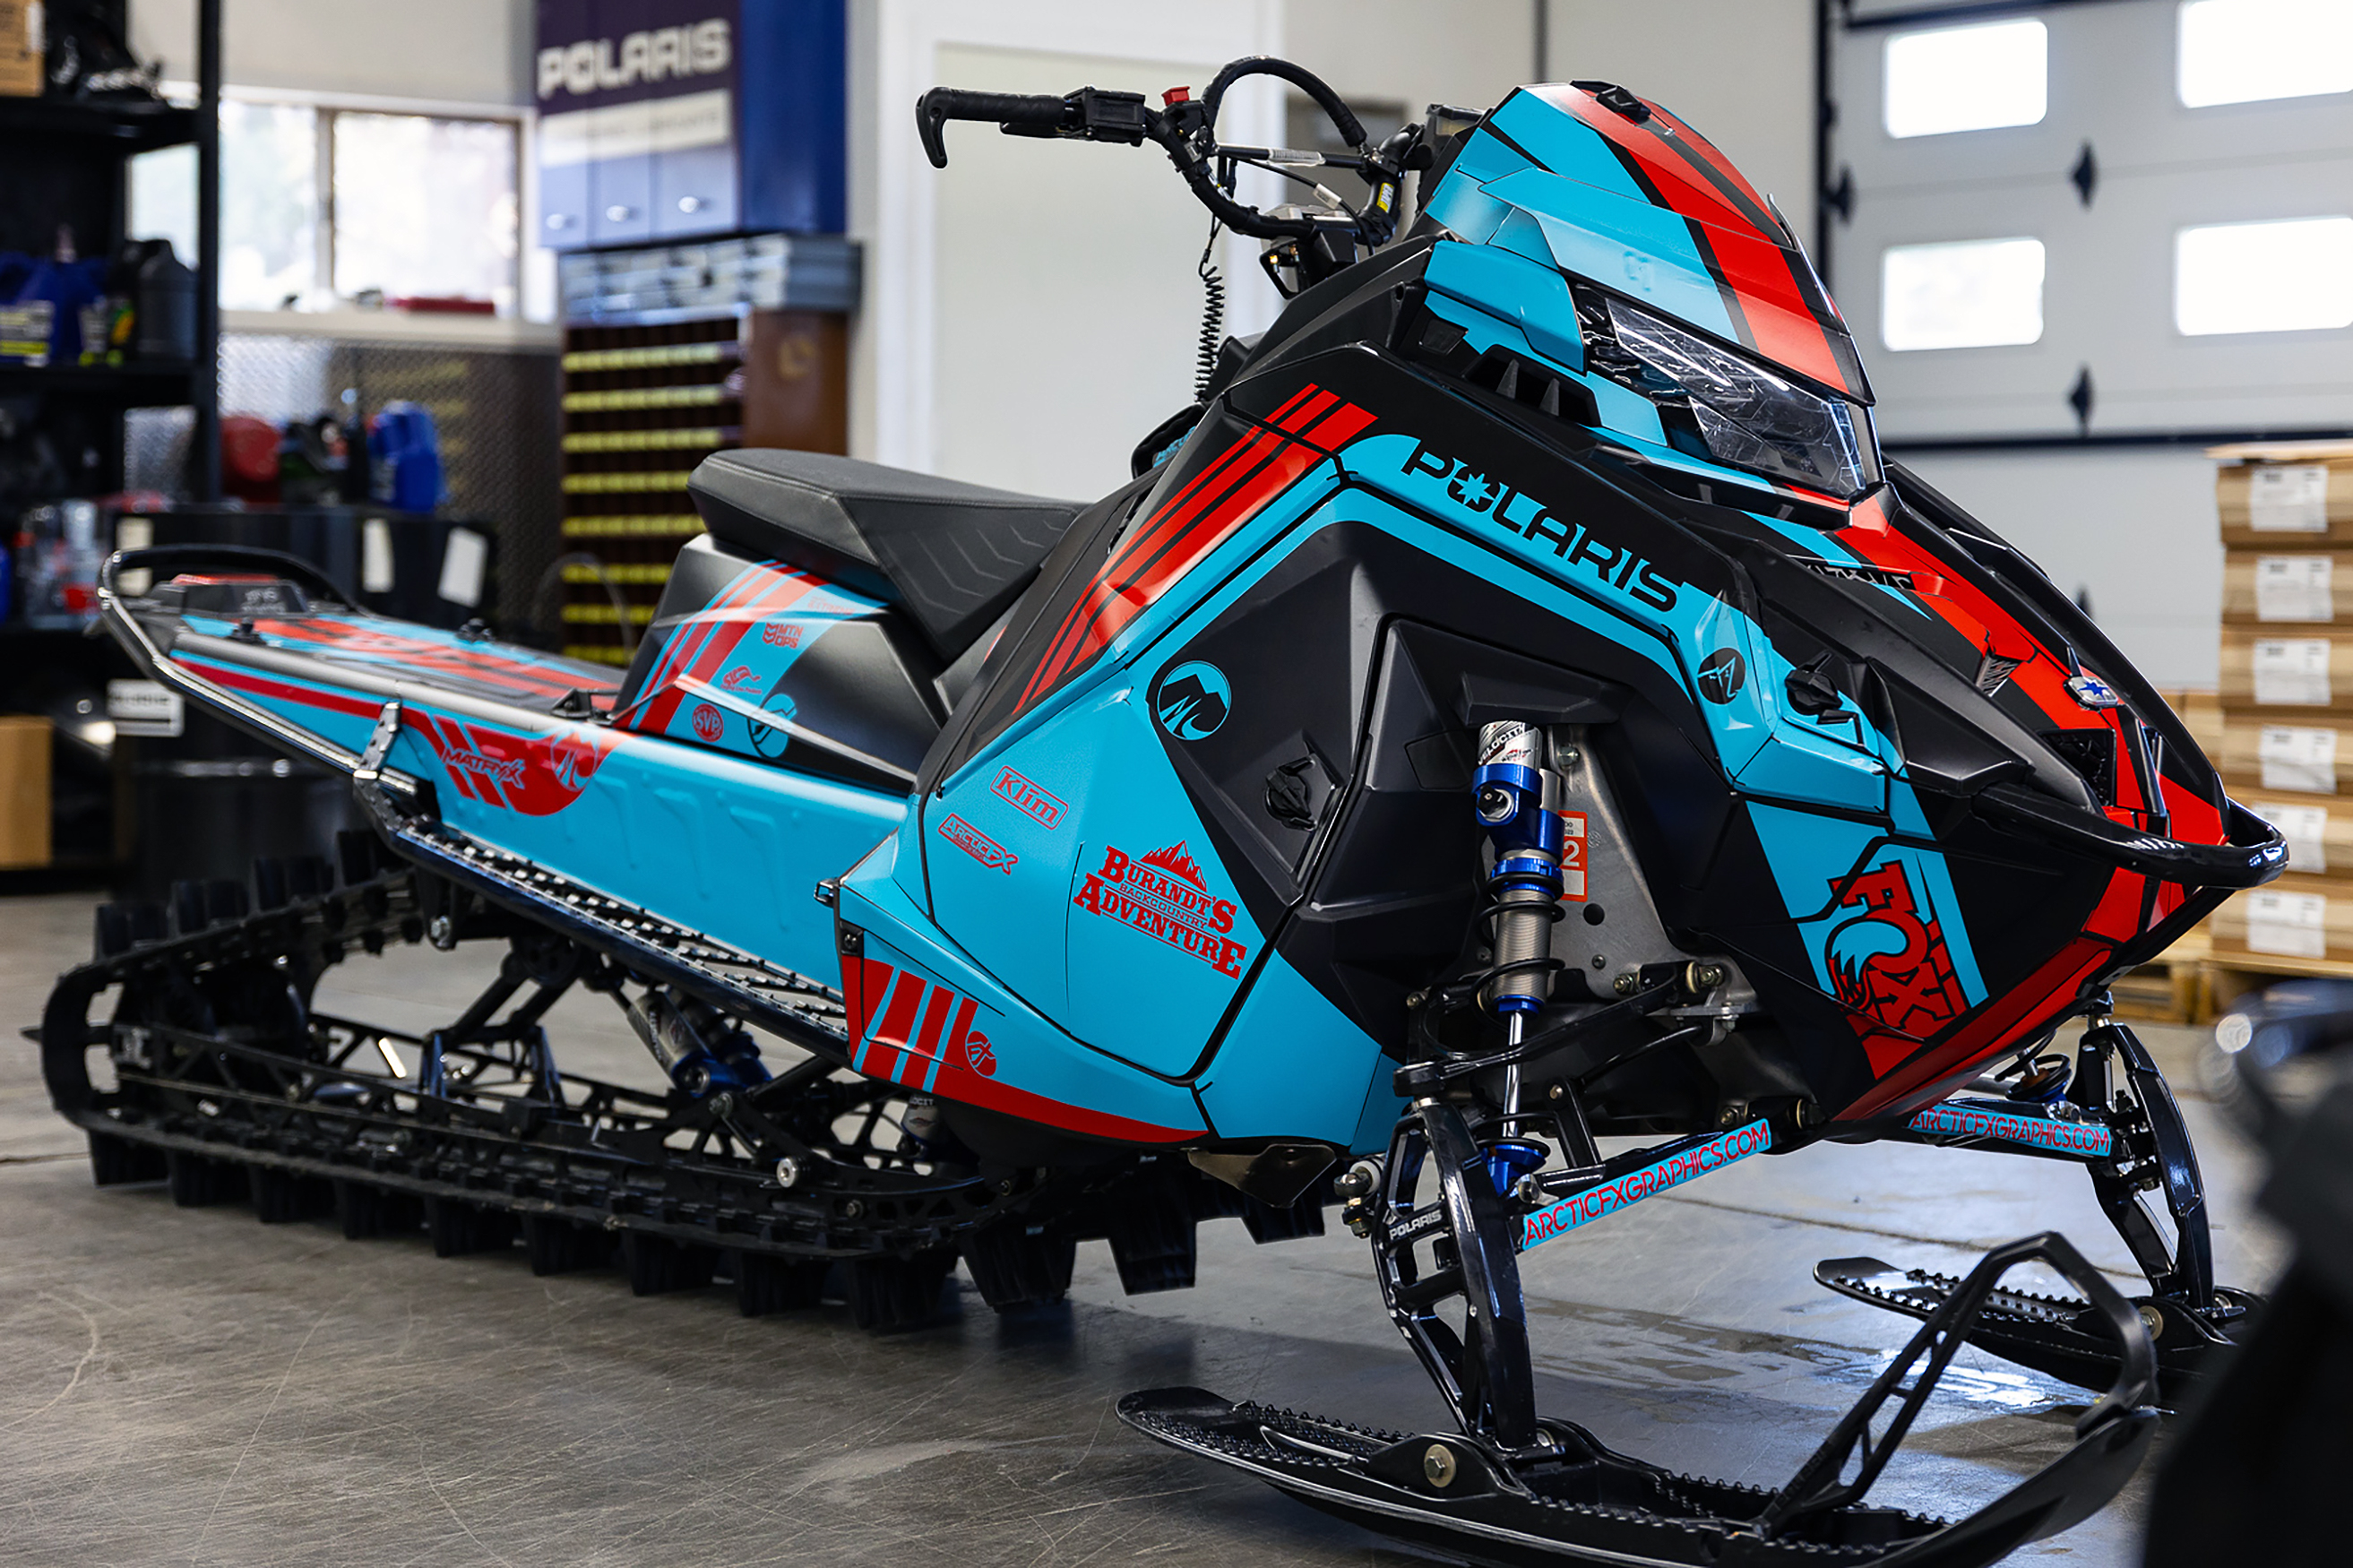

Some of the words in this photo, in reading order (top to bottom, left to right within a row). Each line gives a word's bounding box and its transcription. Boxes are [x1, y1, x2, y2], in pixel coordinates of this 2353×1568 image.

[538, 17, 731, 100] POLARIS
[1401, 440, 1677, 613] POLARIS
[774, 635, 799, 649] OPS
[777, 625, 804, 638] MTN
[1098, 845, 1237, 934] BURANDT'S
[1119, 883, 1207, 929] BACKCOUNTRY
[1073, 872, 1247, 980] ADVENTURE
[1910, 1108, 2110, 1153] ARCTICFXGRAPHICS.COM
[1525, 1122, 1769, 1246] ARCTICFXGRAPHICS.COM
[1389, 1210, 1443, 1240] POLARIS
